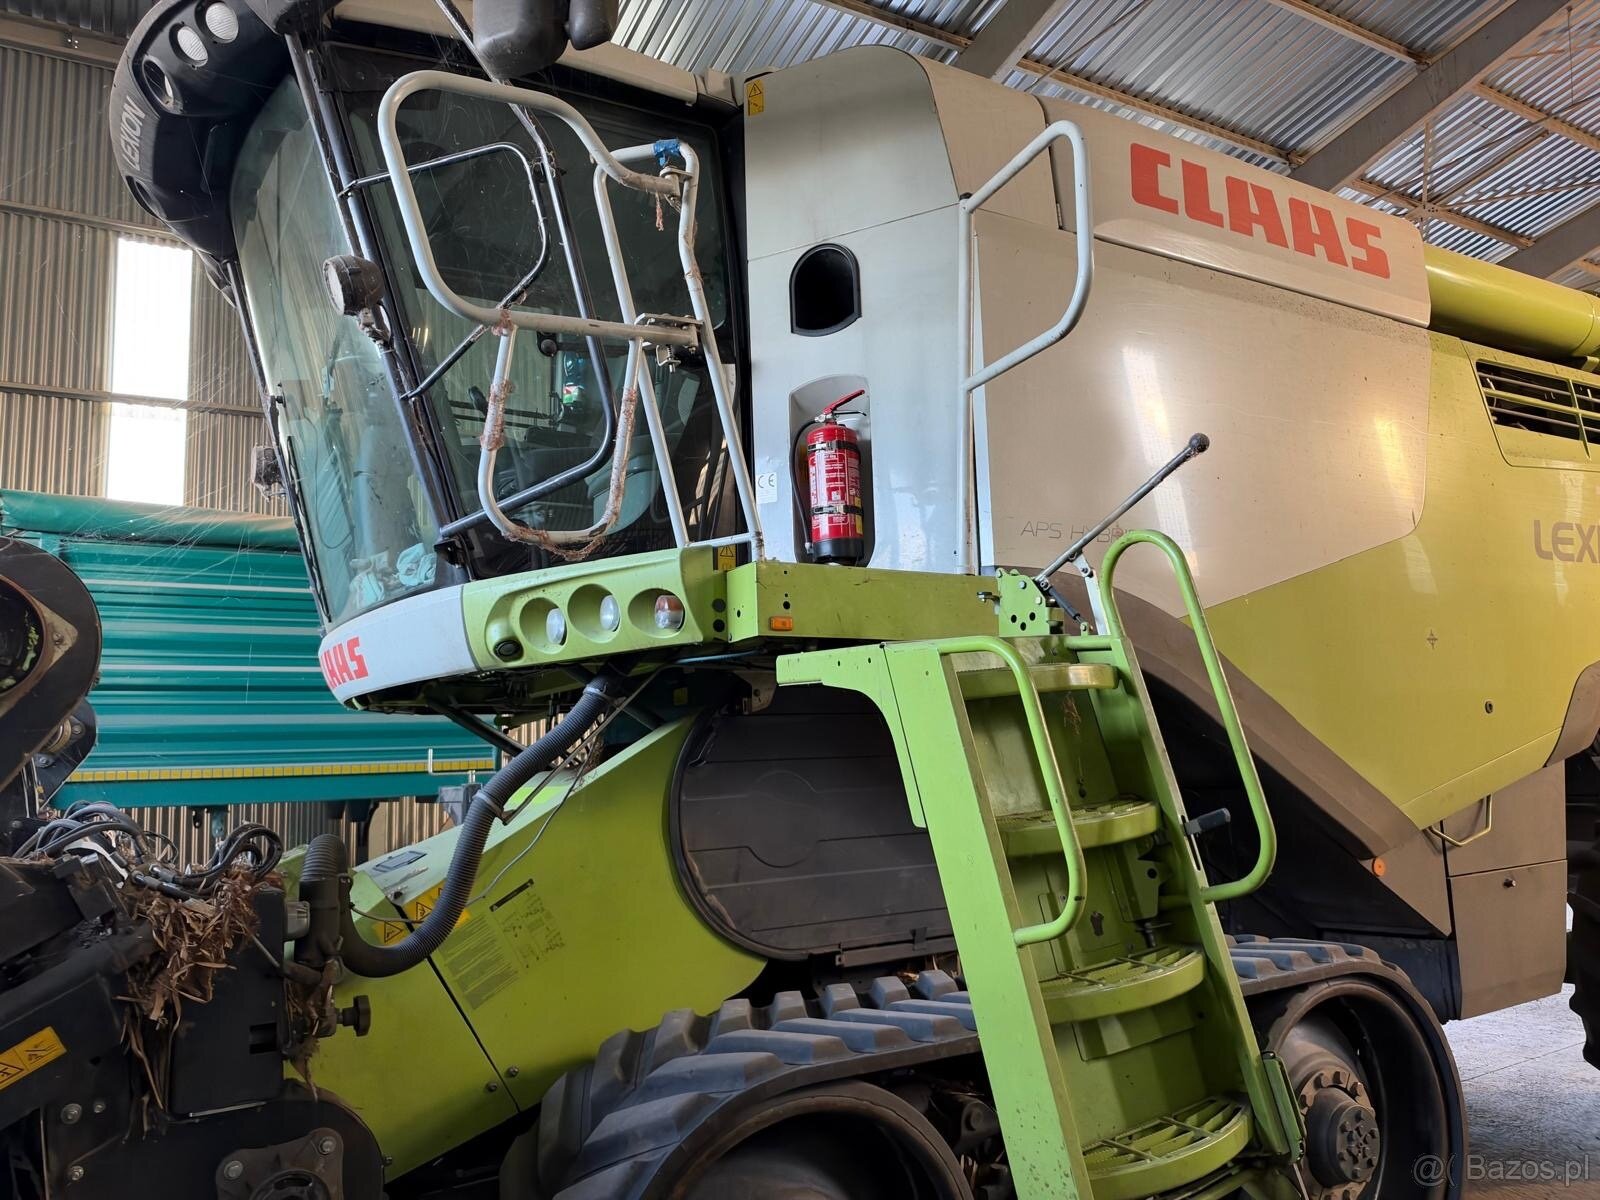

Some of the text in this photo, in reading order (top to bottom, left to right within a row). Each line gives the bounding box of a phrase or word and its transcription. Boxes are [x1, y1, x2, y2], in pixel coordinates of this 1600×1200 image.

[120, 95, 146, 171] LEXION
[1130, 143, 1390, 279] CLAAS
[1020, 520, 1062, 539] APS
